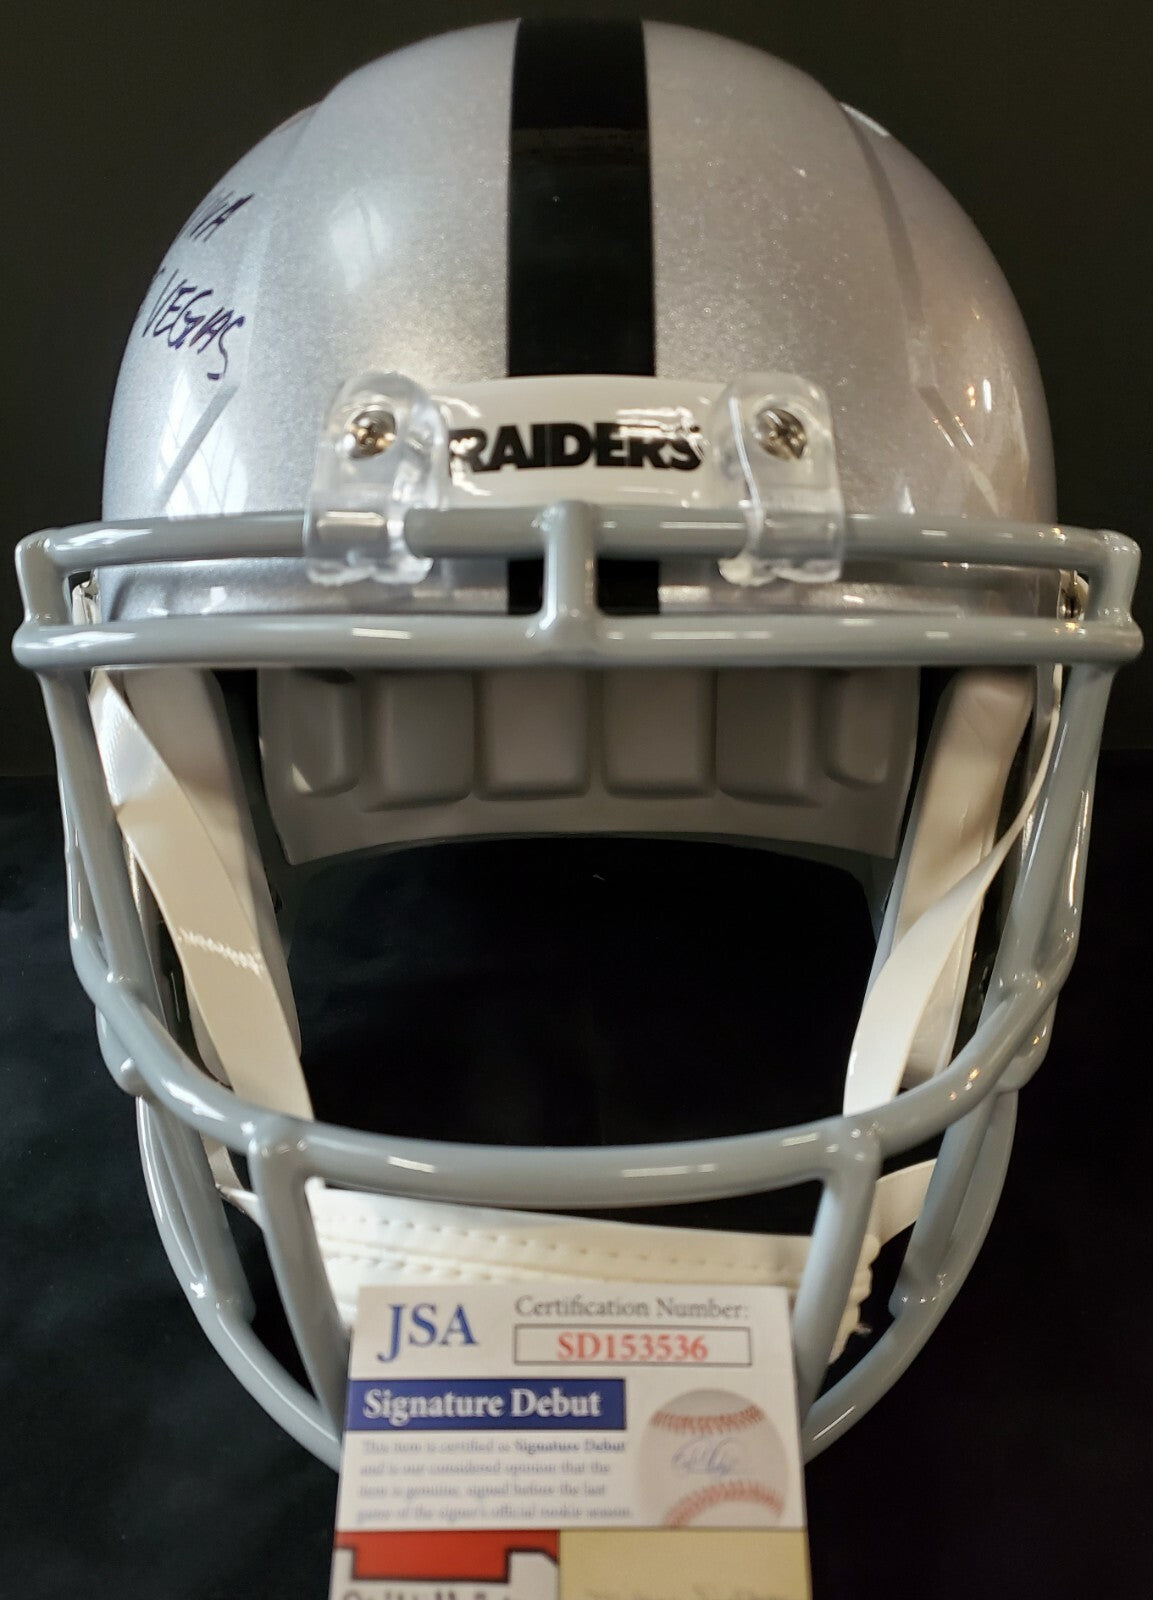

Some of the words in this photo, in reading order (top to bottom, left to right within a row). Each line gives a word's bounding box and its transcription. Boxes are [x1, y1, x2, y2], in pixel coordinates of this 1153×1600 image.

[142, 268, 246, 381] VEGAS
[449, 422, 703, 473] RAIDERS
[514, 1296, 649, 1317] Certification
[656, 1298, 749, 1319] Number:
[376, 1302, 478, 1363] JSA
[556, 1331, 709, 1362] SD153536
[362, 1388, 504, 1427] Signature
[510, 1387, 602, 1418] Debut
